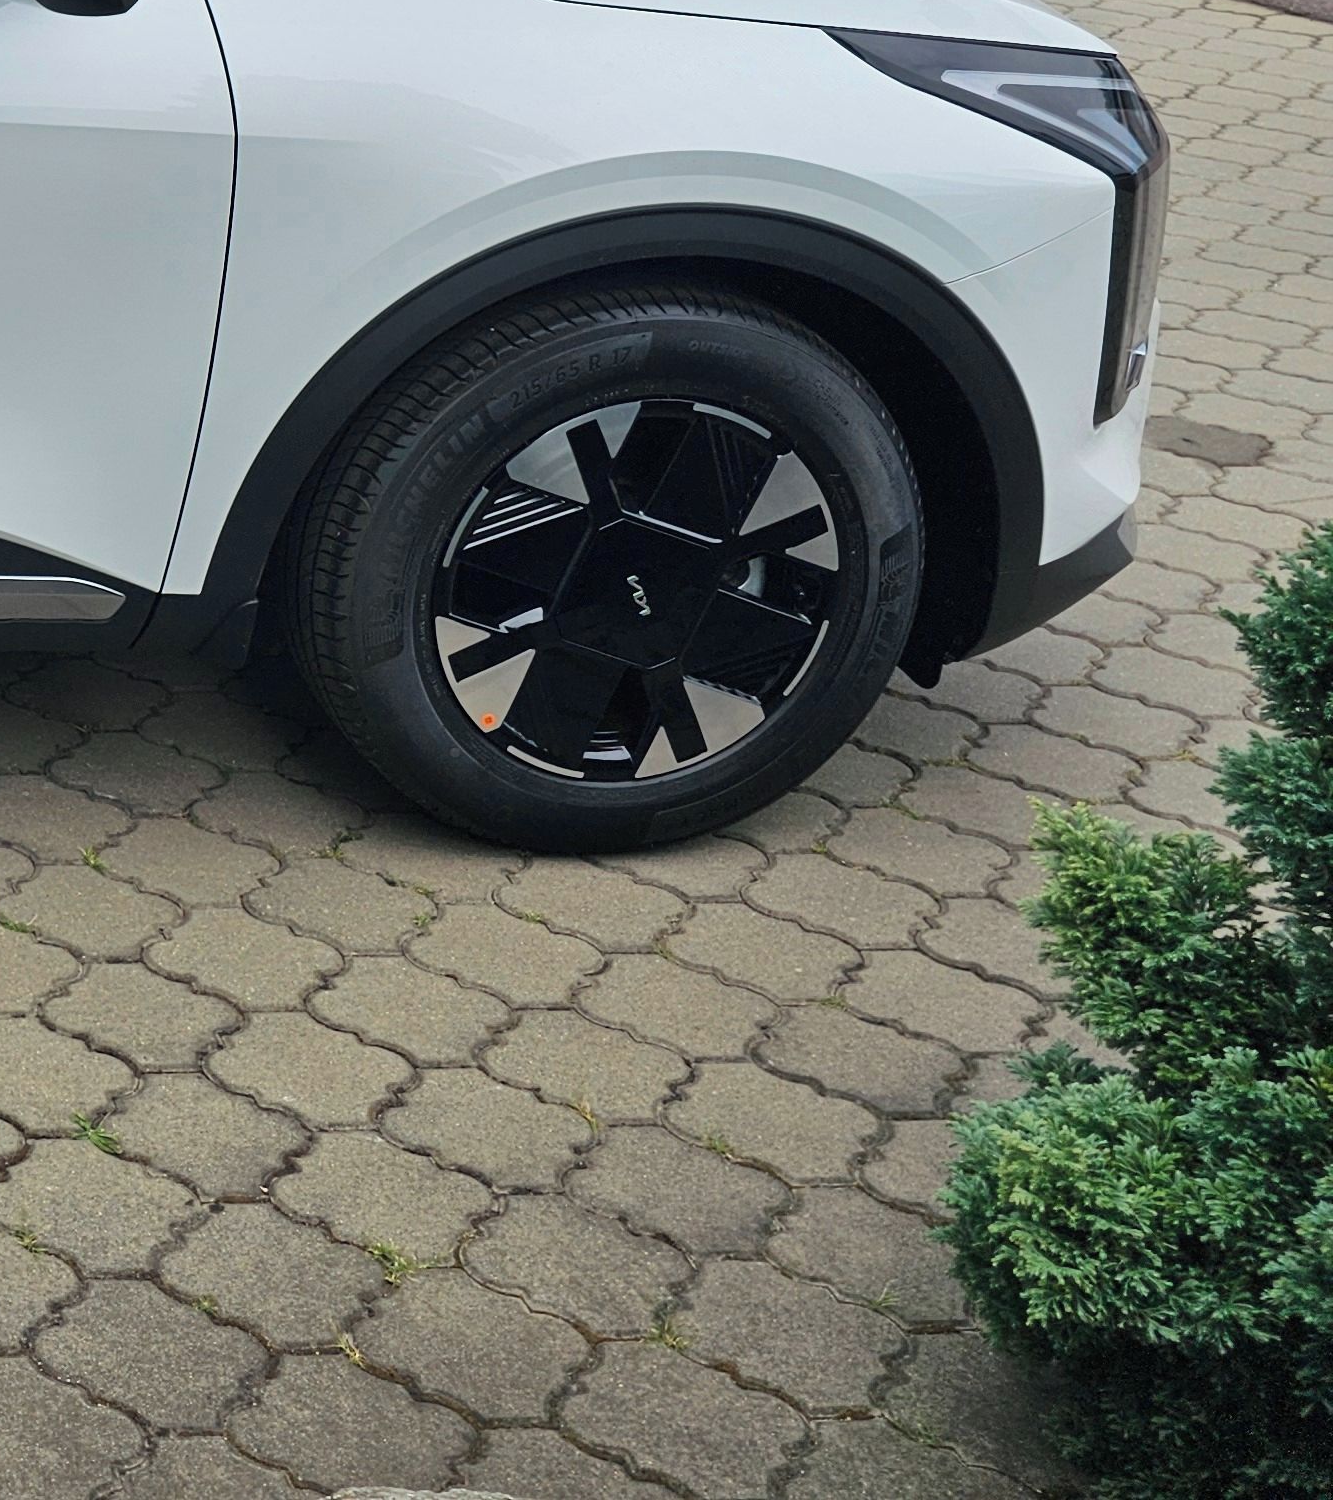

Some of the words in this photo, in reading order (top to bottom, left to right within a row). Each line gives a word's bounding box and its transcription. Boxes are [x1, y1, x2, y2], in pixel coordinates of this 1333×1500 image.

[509, 362, 581, 411] 215/65
[587, 353, 603, 374] R
[610, 345, 632, 368] 17
